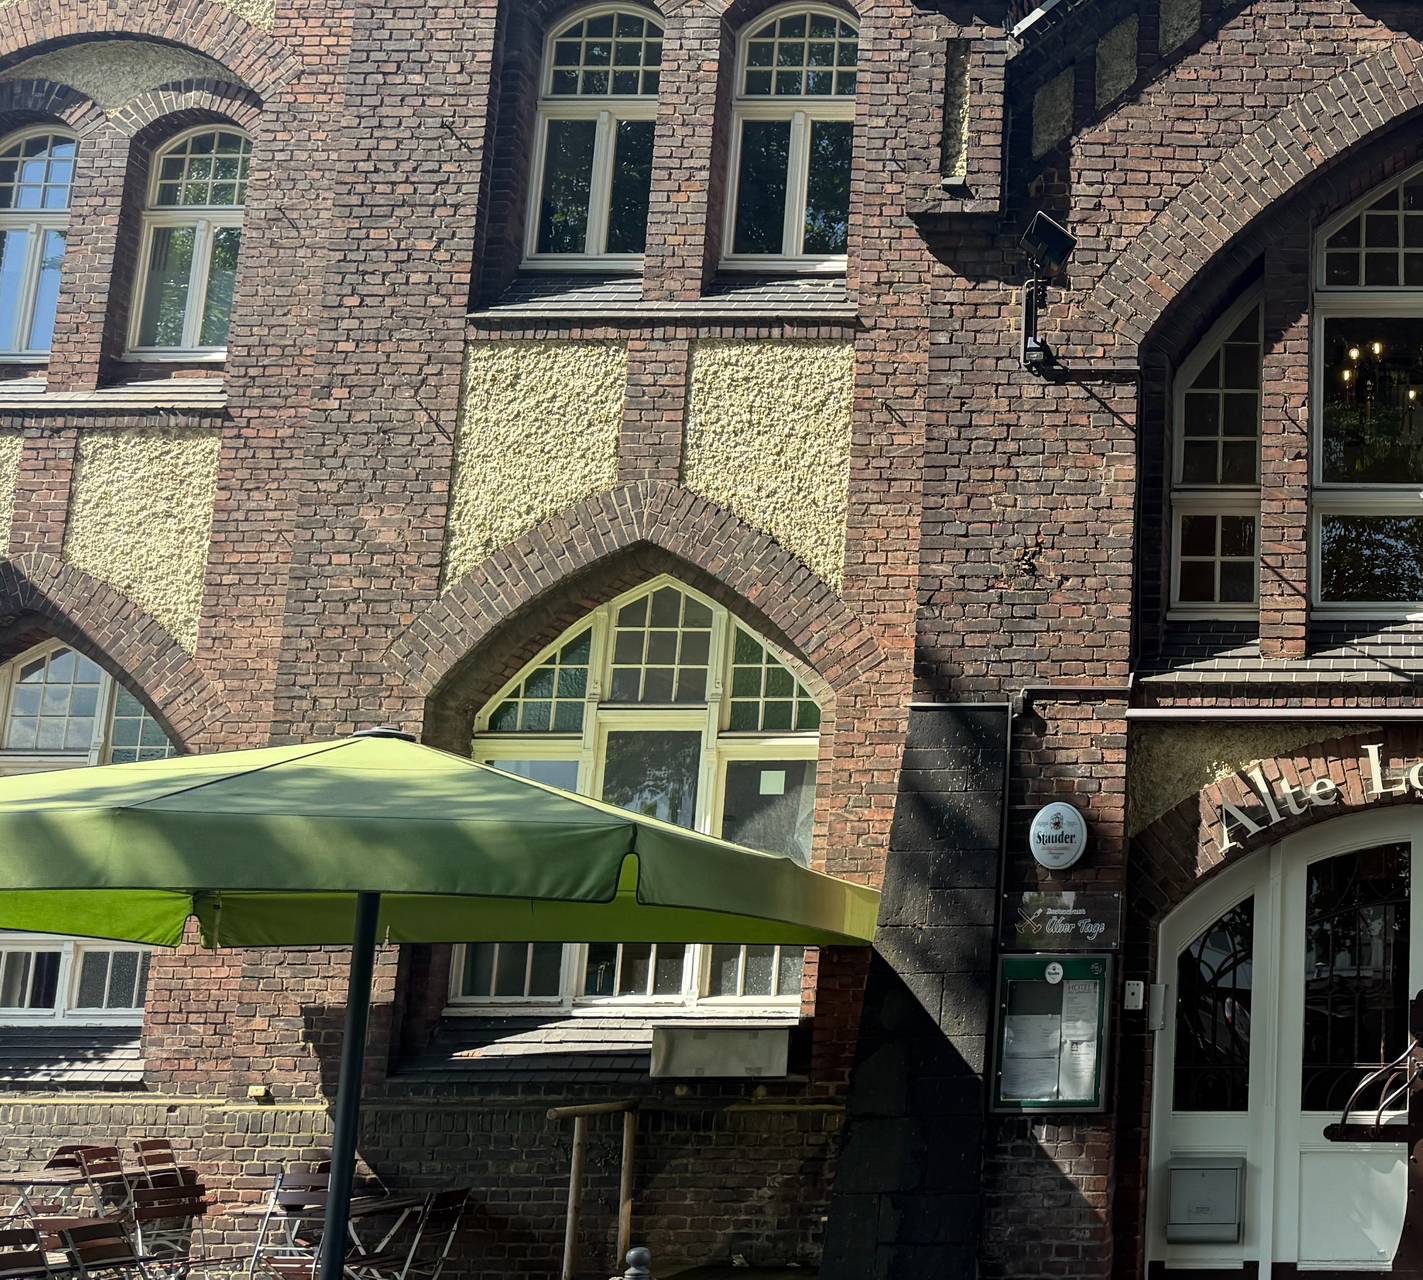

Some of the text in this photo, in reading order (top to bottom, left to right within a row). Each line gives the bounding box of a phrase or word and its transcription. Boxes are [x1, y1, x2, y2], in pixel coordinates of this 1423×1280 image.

[1215, 760, 1338, 853] Alte
[1036, 831, 1076, 845] Stauder
[1077, 918, 1105, 941] Tage
